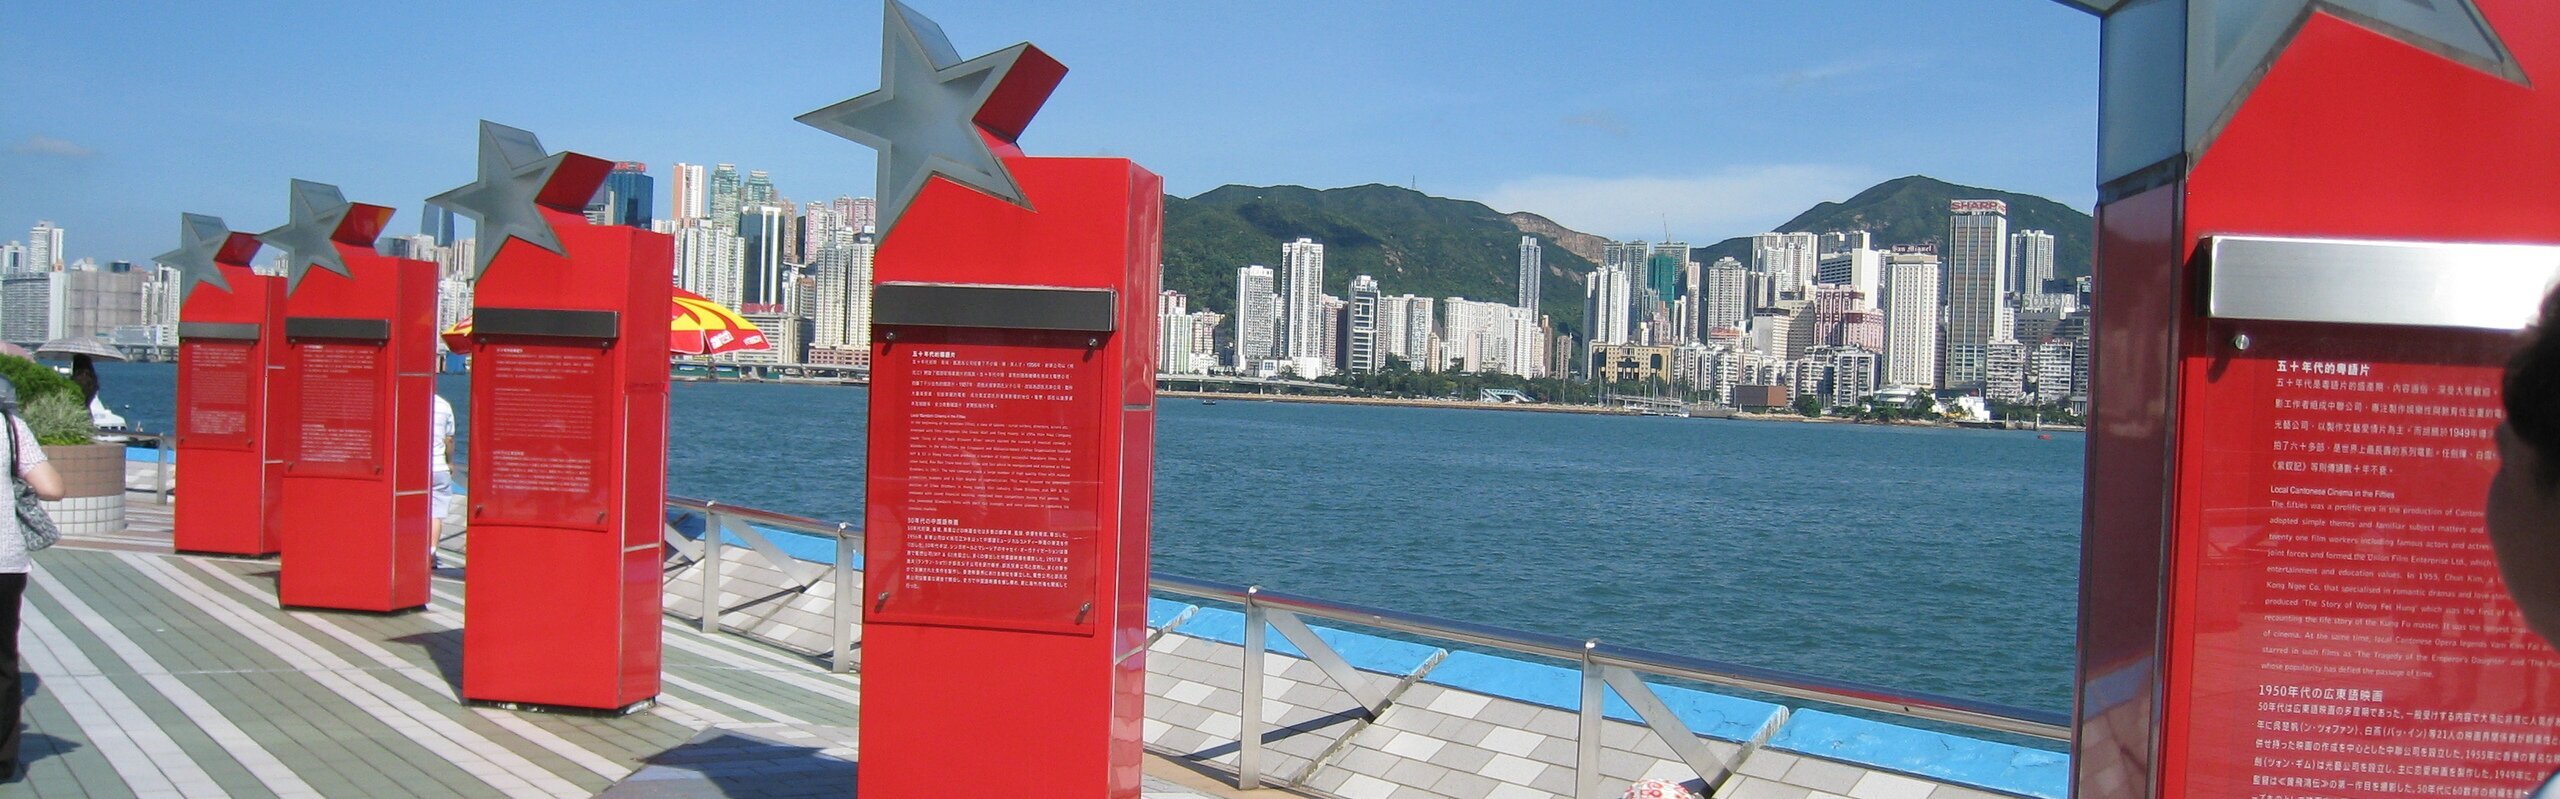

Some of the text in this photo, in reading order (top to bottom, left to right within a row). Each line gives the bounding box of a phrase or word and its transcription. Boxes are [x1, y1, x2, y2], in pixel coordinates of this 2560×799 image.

[1951, 202, 1998, 210] SHARP
[2258, 684, 2384, 702] 1950年代の広東語映画
